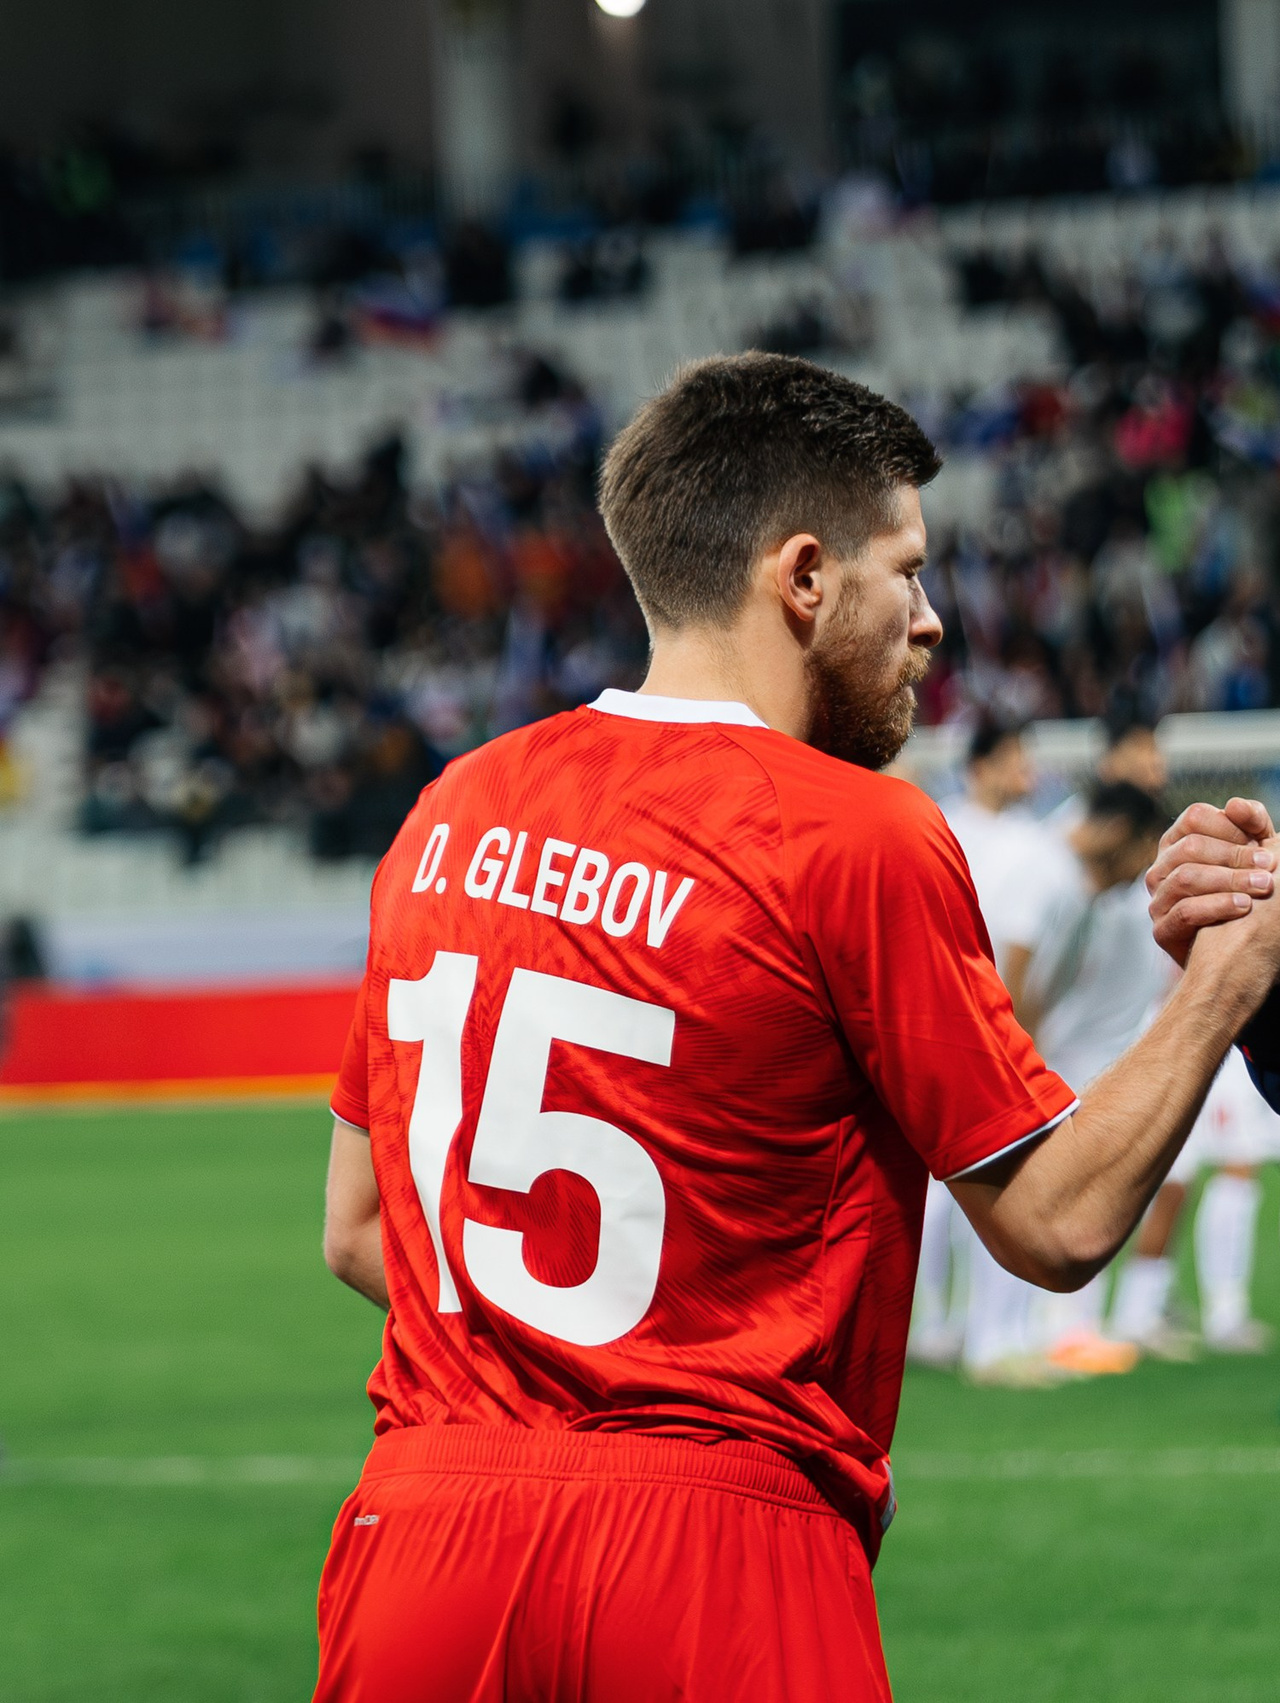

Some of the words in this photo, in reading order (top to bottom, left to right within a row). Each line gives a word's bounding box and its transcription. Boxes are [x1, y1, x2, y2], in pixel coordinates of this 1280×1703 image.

[411, 823, 449, 895] D.
[463, 826, 695, 949] GLEBOV
[387, 950, 676, 1347] 15
